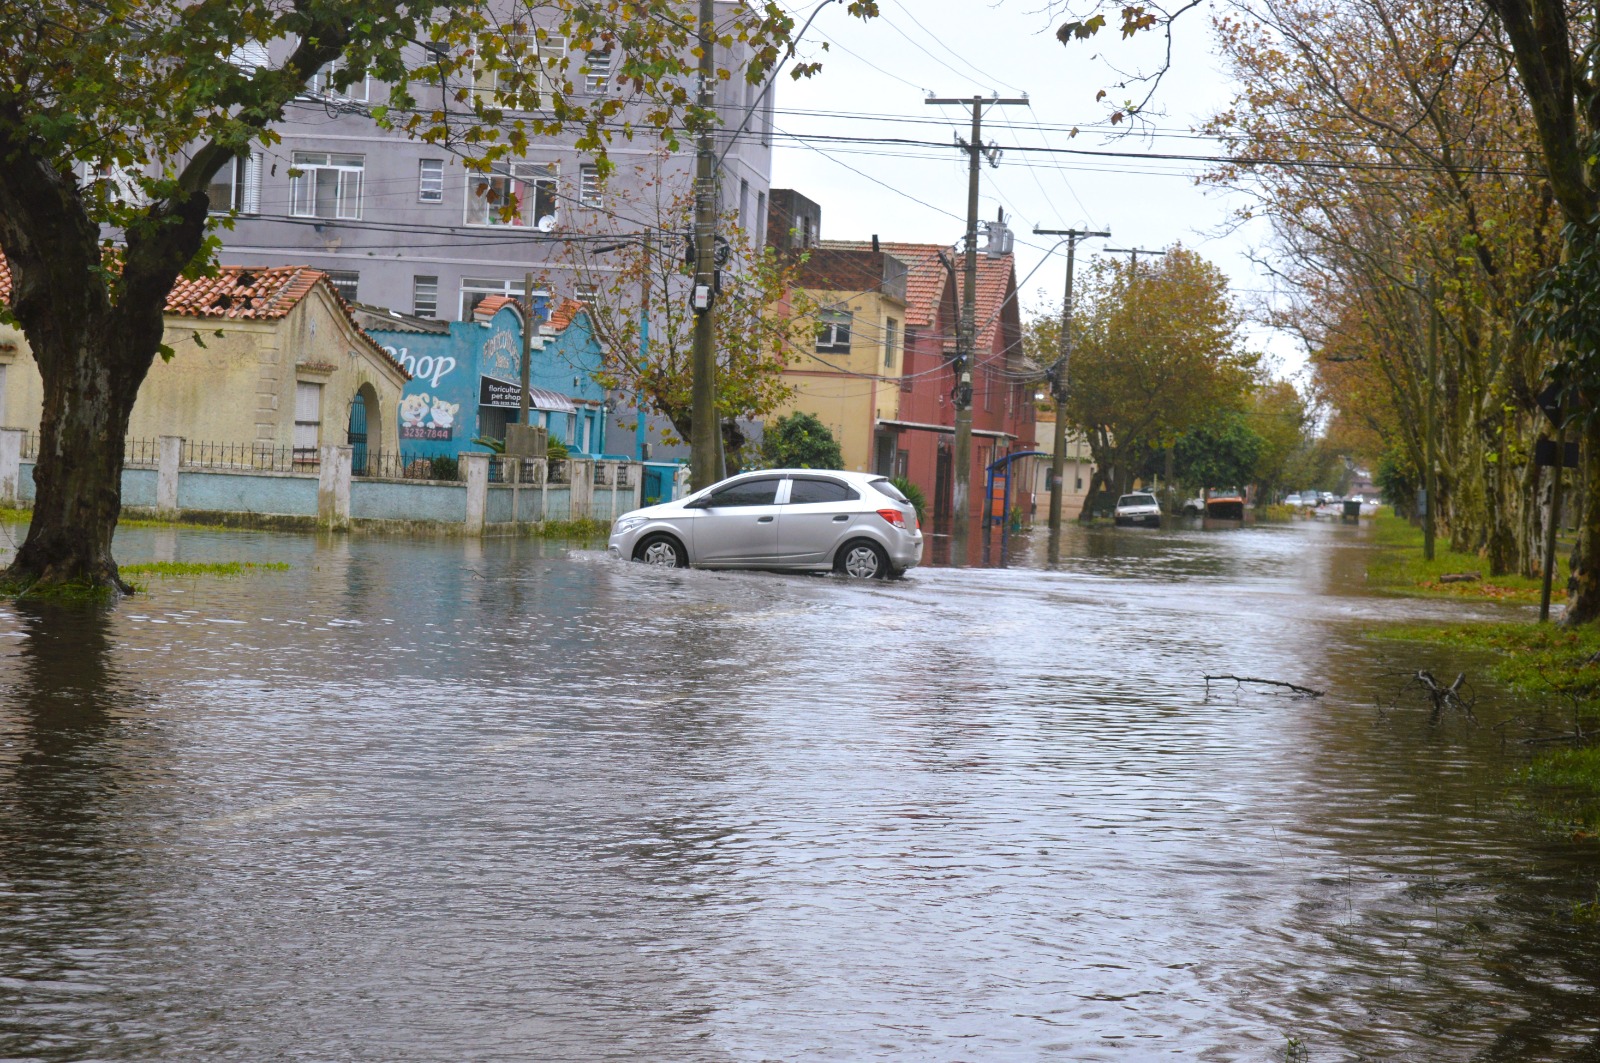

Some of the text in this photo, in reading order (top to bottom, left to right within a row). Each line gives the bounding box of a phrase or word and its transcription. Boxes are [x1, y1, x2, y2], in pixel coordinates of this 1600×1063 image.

[488, 384, 521, 393] floricultur
[491, 393, 521, 403] pet shop
